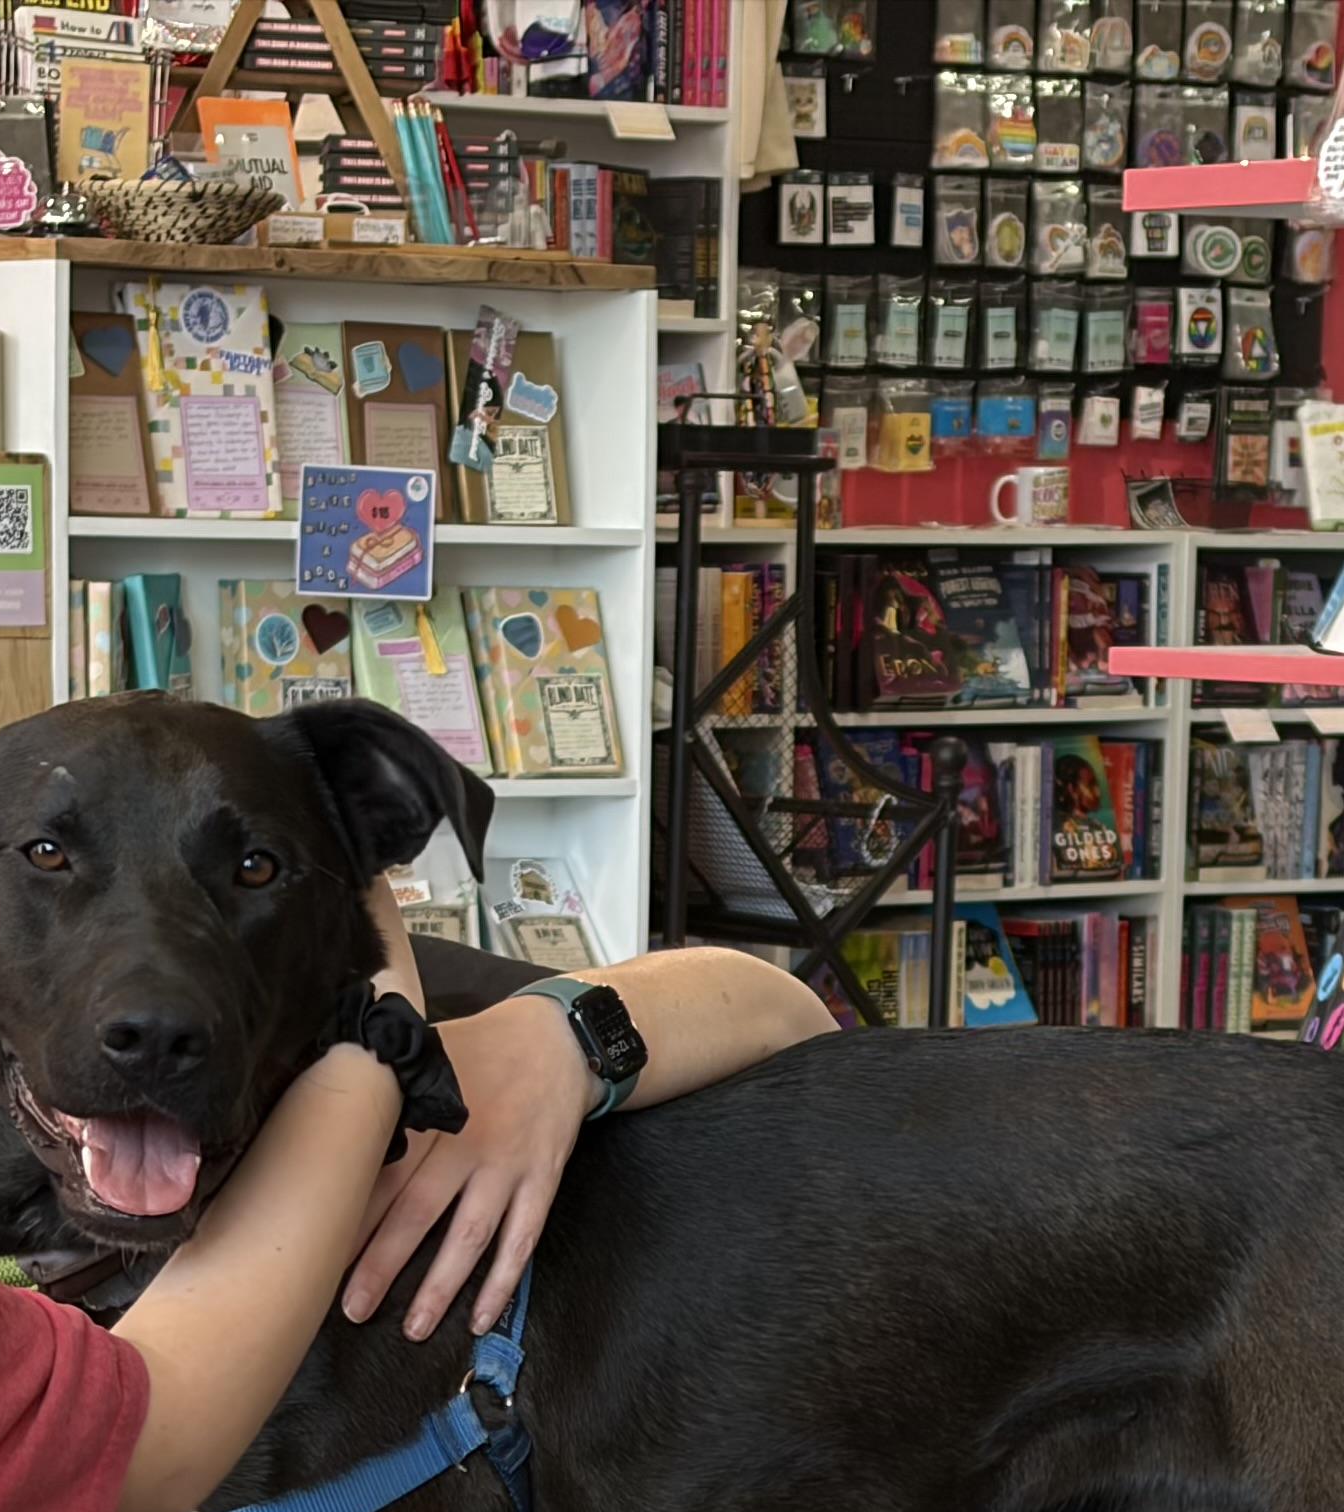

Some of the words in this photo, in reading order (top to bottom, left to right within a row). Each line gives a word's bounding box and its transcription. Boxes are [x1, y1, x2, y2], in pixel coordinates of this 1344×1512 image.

[250, 174, 273, 191] AID
[306, 471, 359, 488] BLIND
[303, 566, 350, 592] BOOK
[1054, 830, 1117, 848] GILDED
[1065, 845, 1113, 862] ONES
